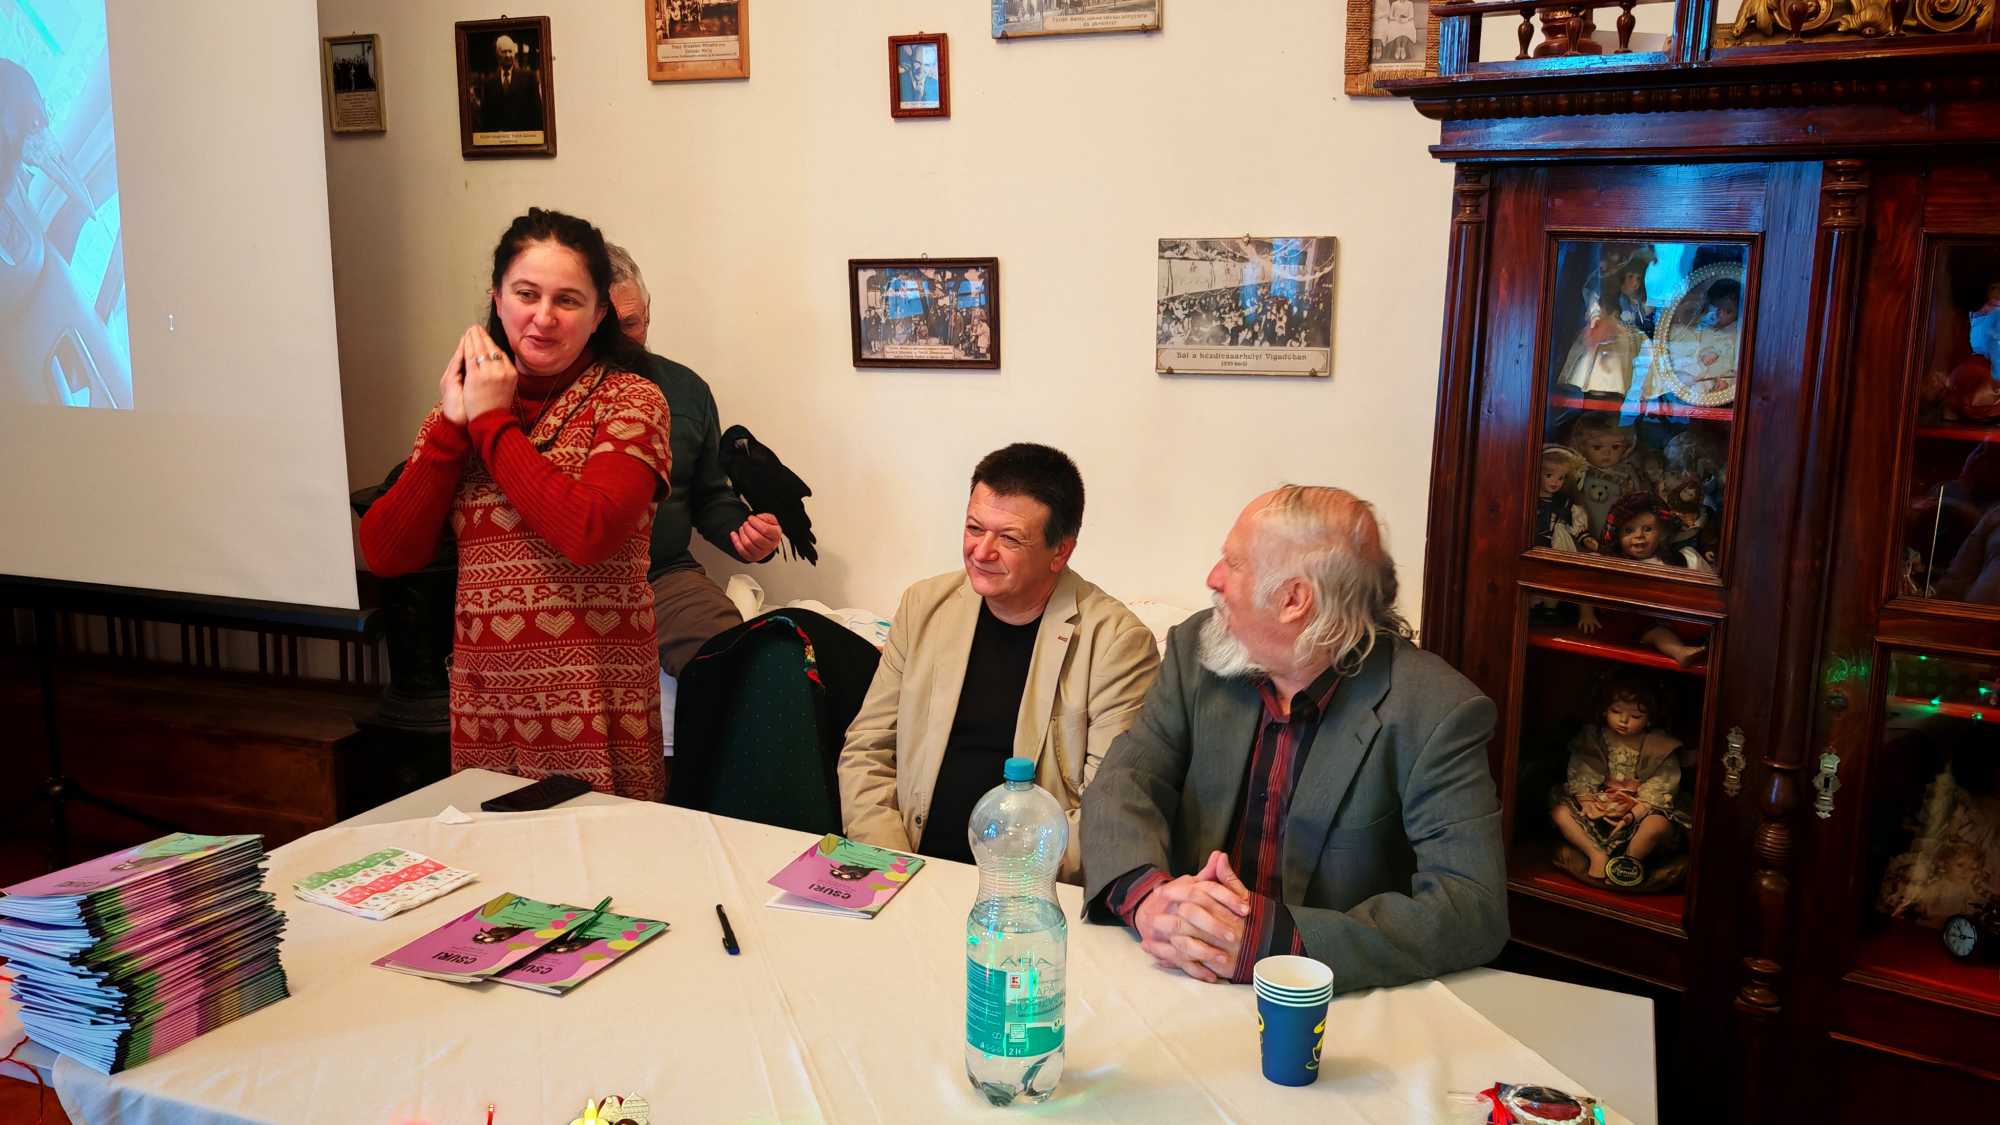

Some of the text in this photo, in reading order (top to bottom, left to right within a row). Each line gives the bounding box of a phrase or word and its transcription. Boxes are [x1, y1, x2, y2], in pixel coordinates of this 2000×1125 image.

[809, 883, 851, 899] CSURI
[432, 951, 478, 965] CSURI
[519, 962, 553, 975] CSU
